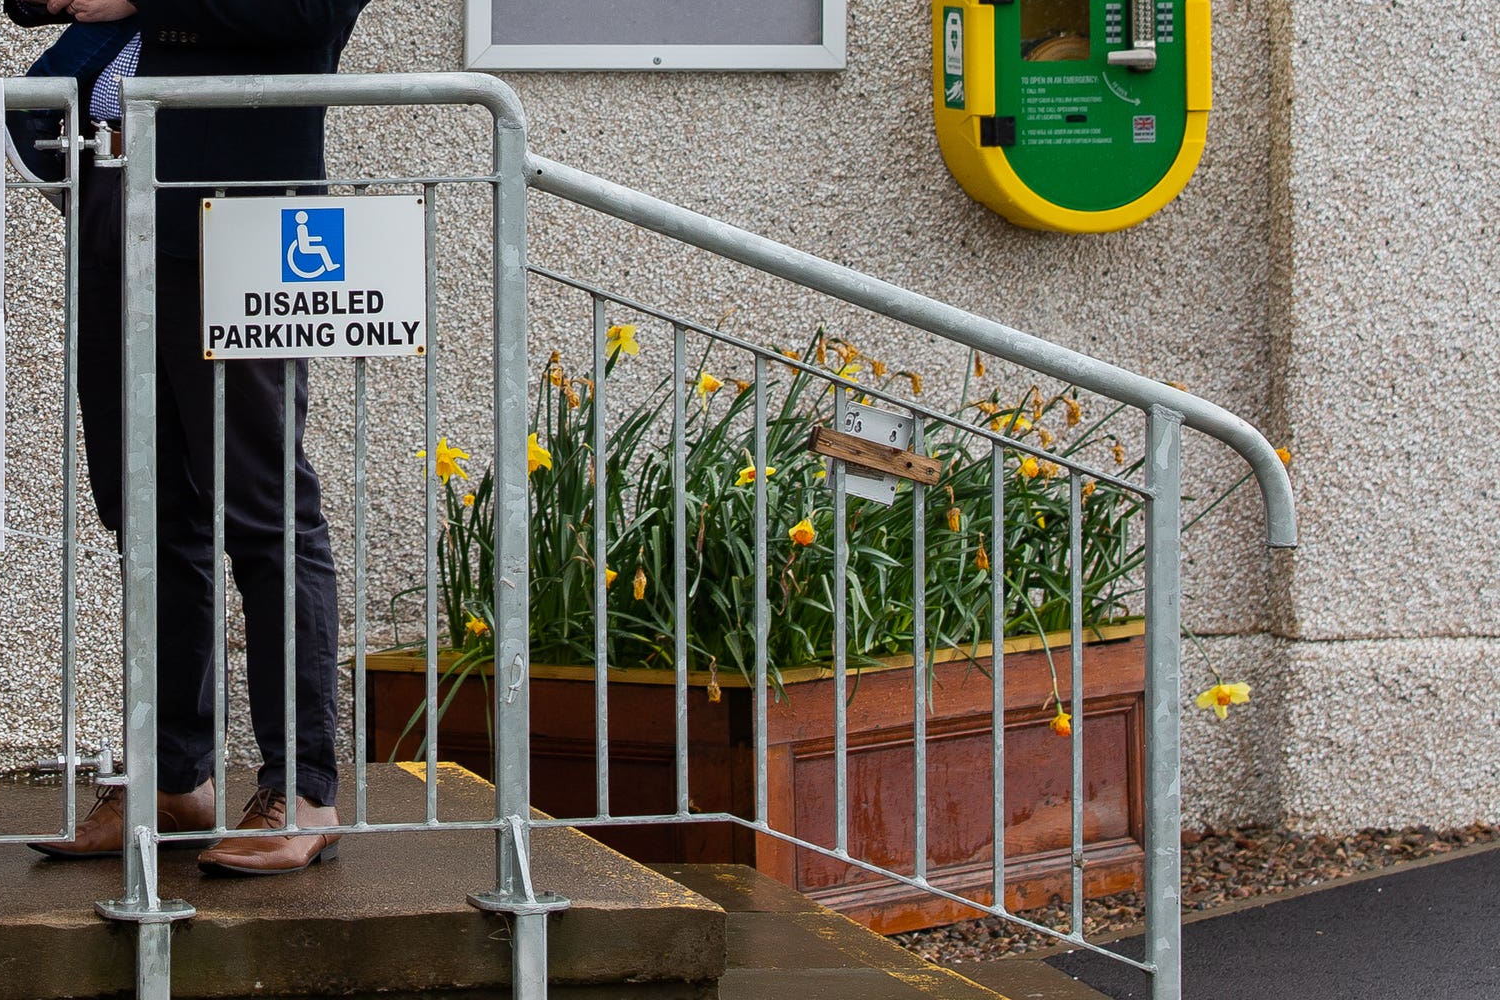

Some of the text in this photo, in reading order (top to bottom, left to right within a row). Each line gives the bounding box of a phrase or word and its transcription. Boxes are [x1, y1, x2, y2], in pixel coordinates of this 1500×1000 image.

[244, 290, 384, 317] DISABLED
[208, 321, 421, 350] PARKING ONLY
